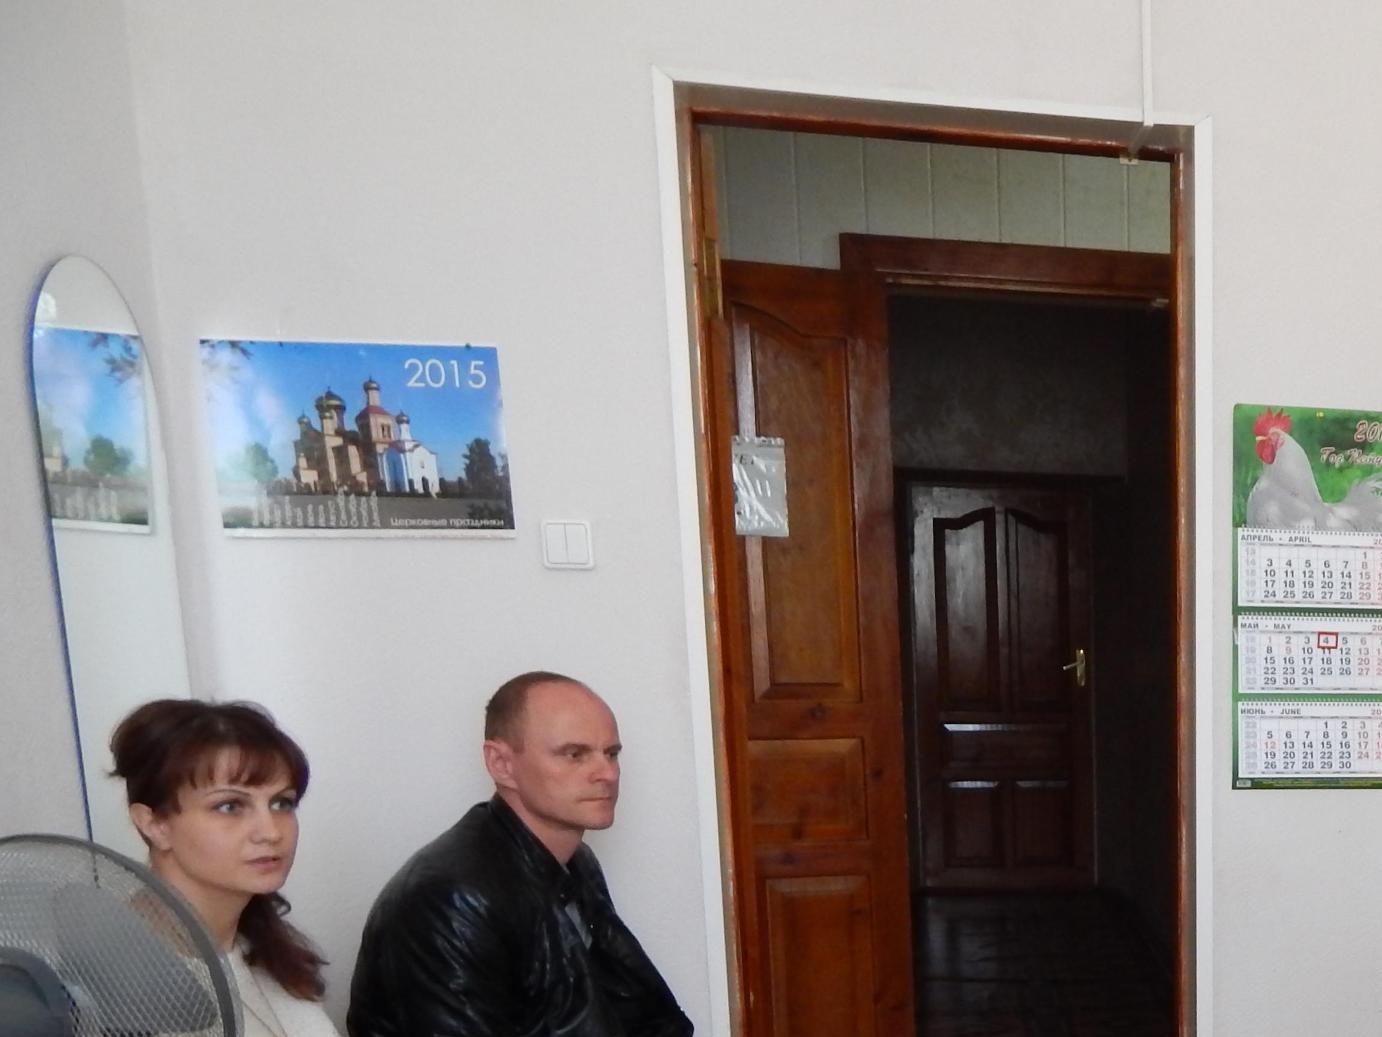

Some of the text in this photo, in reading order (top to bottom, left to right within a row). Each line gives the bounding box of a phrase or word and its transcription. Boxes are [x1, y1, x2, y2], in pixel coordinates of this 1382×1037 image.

[404, 358, 487, 388] 2015
[1240, 534, 1274, 542] АПРЕЛЬ
[1267, 558, 1273, 567] 3
[1285, 560, 1292, 568] 4
[1305, 560, 1311, 568] 5
[1324, 560, 1330, 568] 6
[1343, 560, 1349, 569] 7
[1361, 561, 1368, 570] 8
[1264, 569, 1276, 578] 10
[1284, 570, 1294, 578] 11
[1302, 570, 1314, 578] 12
[1322, 570, 1333, 579] 13
[1340, 571, 1352, 579] 14
[1359, 571, 1371, 580] 15
[1264, 580, 1276, 588] 17
[1283, 580, 1295, 588] 18
[1303, 580, 1314, 588] 19
[1321, 581, 1334, 589] 20
[1341, 581, 1352, 590] 21
[1358, 582, 1371, 590] 22
[1264, 590, 1277, 598] 24
[1283, 590, 1296, 599] 25
[1302, 590, 1315, 599] 26
[1321, 591, 1333, 600] 27
[1340, 591, 1353, 600] 28
[1358, 592, 1371, 600] 29
[1285, 636, 1292, 644] 2
[1304, 636, 1310, 644] 3
[1323, 635, 1329, 644] 4
[1342, 636, 1348, 645] 5
[1360, 637, 1367, 646] 6
[1266, 646, 1273, 654] 8
[1285, 646, 1292, 655] 9
[1339, 647, 1351, 655] 12
[1358, 647, 1370, 656] 13
[1264, 656, 1276, 664] 15
[1283, 656, 1295, 665] 16
[1302, 657, 1313, 665] 17
[1321, 657, 1332, 665] 18
[1340, 657, 1351, 665] 19
[1357, 657, 1370, 666] 20
[1263, 666, 1276, 675] 22
[1283, 667, 1295, 675] 23
[1301, 667, 1314, 675] 24
[1320, 667, 1333, 676] 25
[1339, 667, 1352, 676] 26
[1358, 667, 1370, 676] 27
[1264, 677, 1314, 685] 29 30 31
[1341, 721, 1347, 729] 2
[1360, 721, 1366, 730] 3
[1267, 730, 1273, 739] 5
[1285, 731, 1292, 739] 6
[1304, 730, 1310, 739] 7
[1323, 731, 1329, 739] 8
[1341, 731, 1348, 739] 9
[1358, 731, 1369, 740] 10
[1264, 741, 1276, 750] 12
[1283, 741, 1295, 749] 13
[1321, 741, 1332, 749] 15
[1339, 741, 1351, 749] 16
[1358, 741, 1369, 750] 17
[1264, 751, 1276, 759] 19
[1283, 751, 1295, 759] 20
[1302, 751, 1313, 759] 21
[1320, 751, 1333, 760] 22
[1339, 751, 1351, 759] 23
[1357, 751, 1369, 760] 24
[1264, 761, 1352, 770] 26 27 28 29 30
